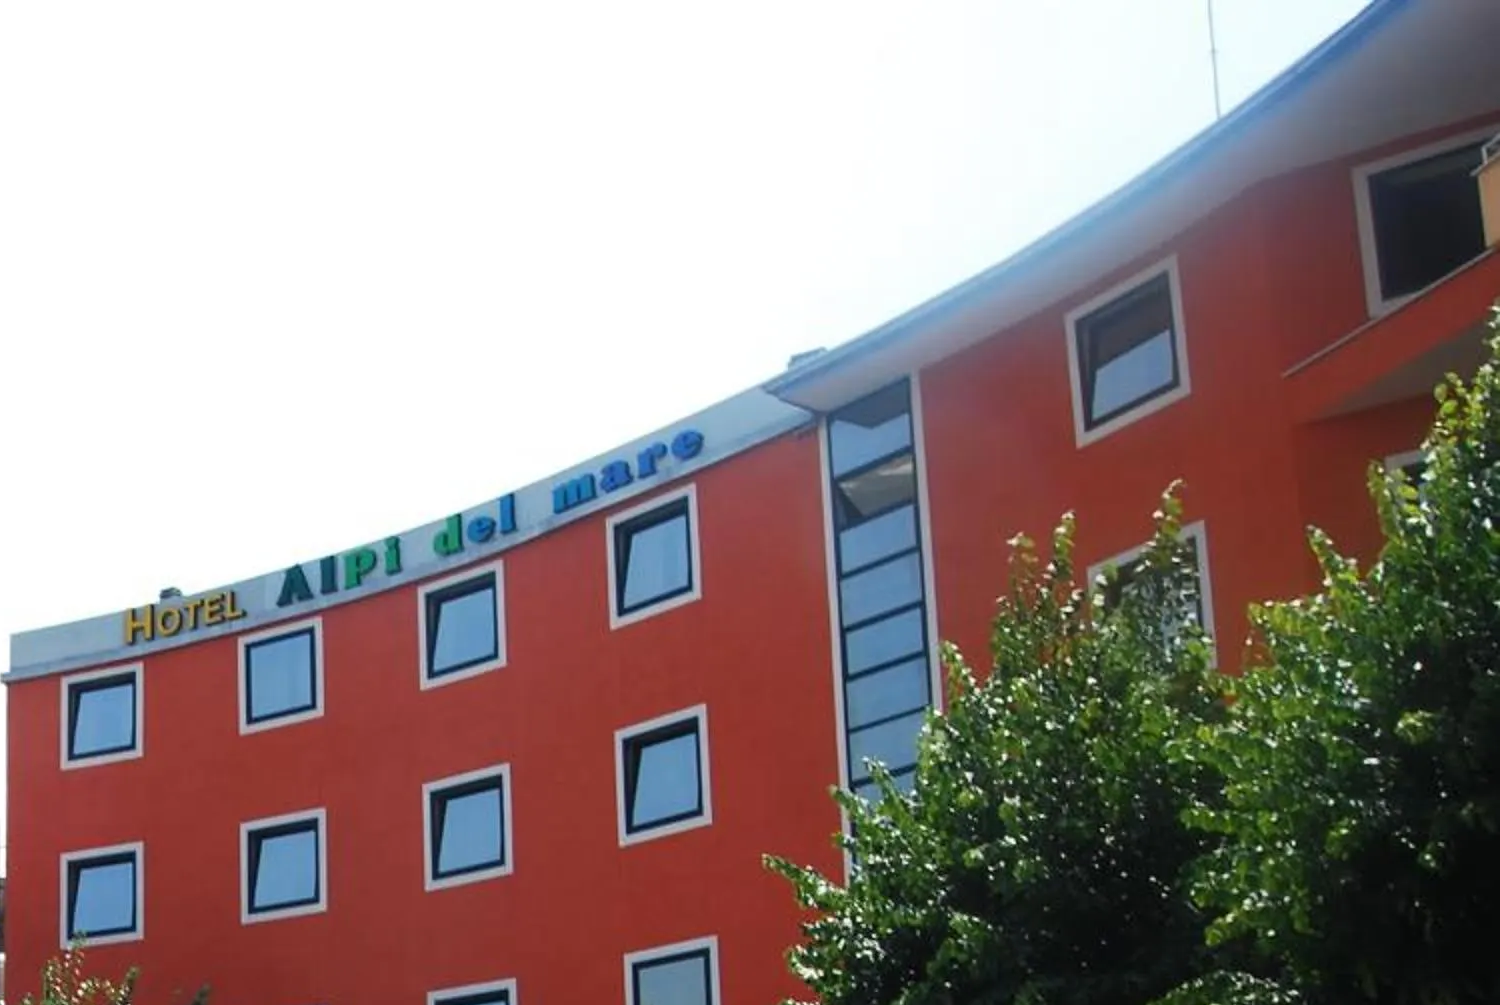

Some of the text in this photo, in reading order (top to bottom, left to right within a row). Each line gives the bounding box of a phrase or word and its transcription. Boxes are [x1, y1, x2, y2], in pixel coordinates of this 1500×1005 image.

[122, 589, 246, 647] HOTEL
[433, 493, 517, 557] del
[551, 427, 705, 515] mare
